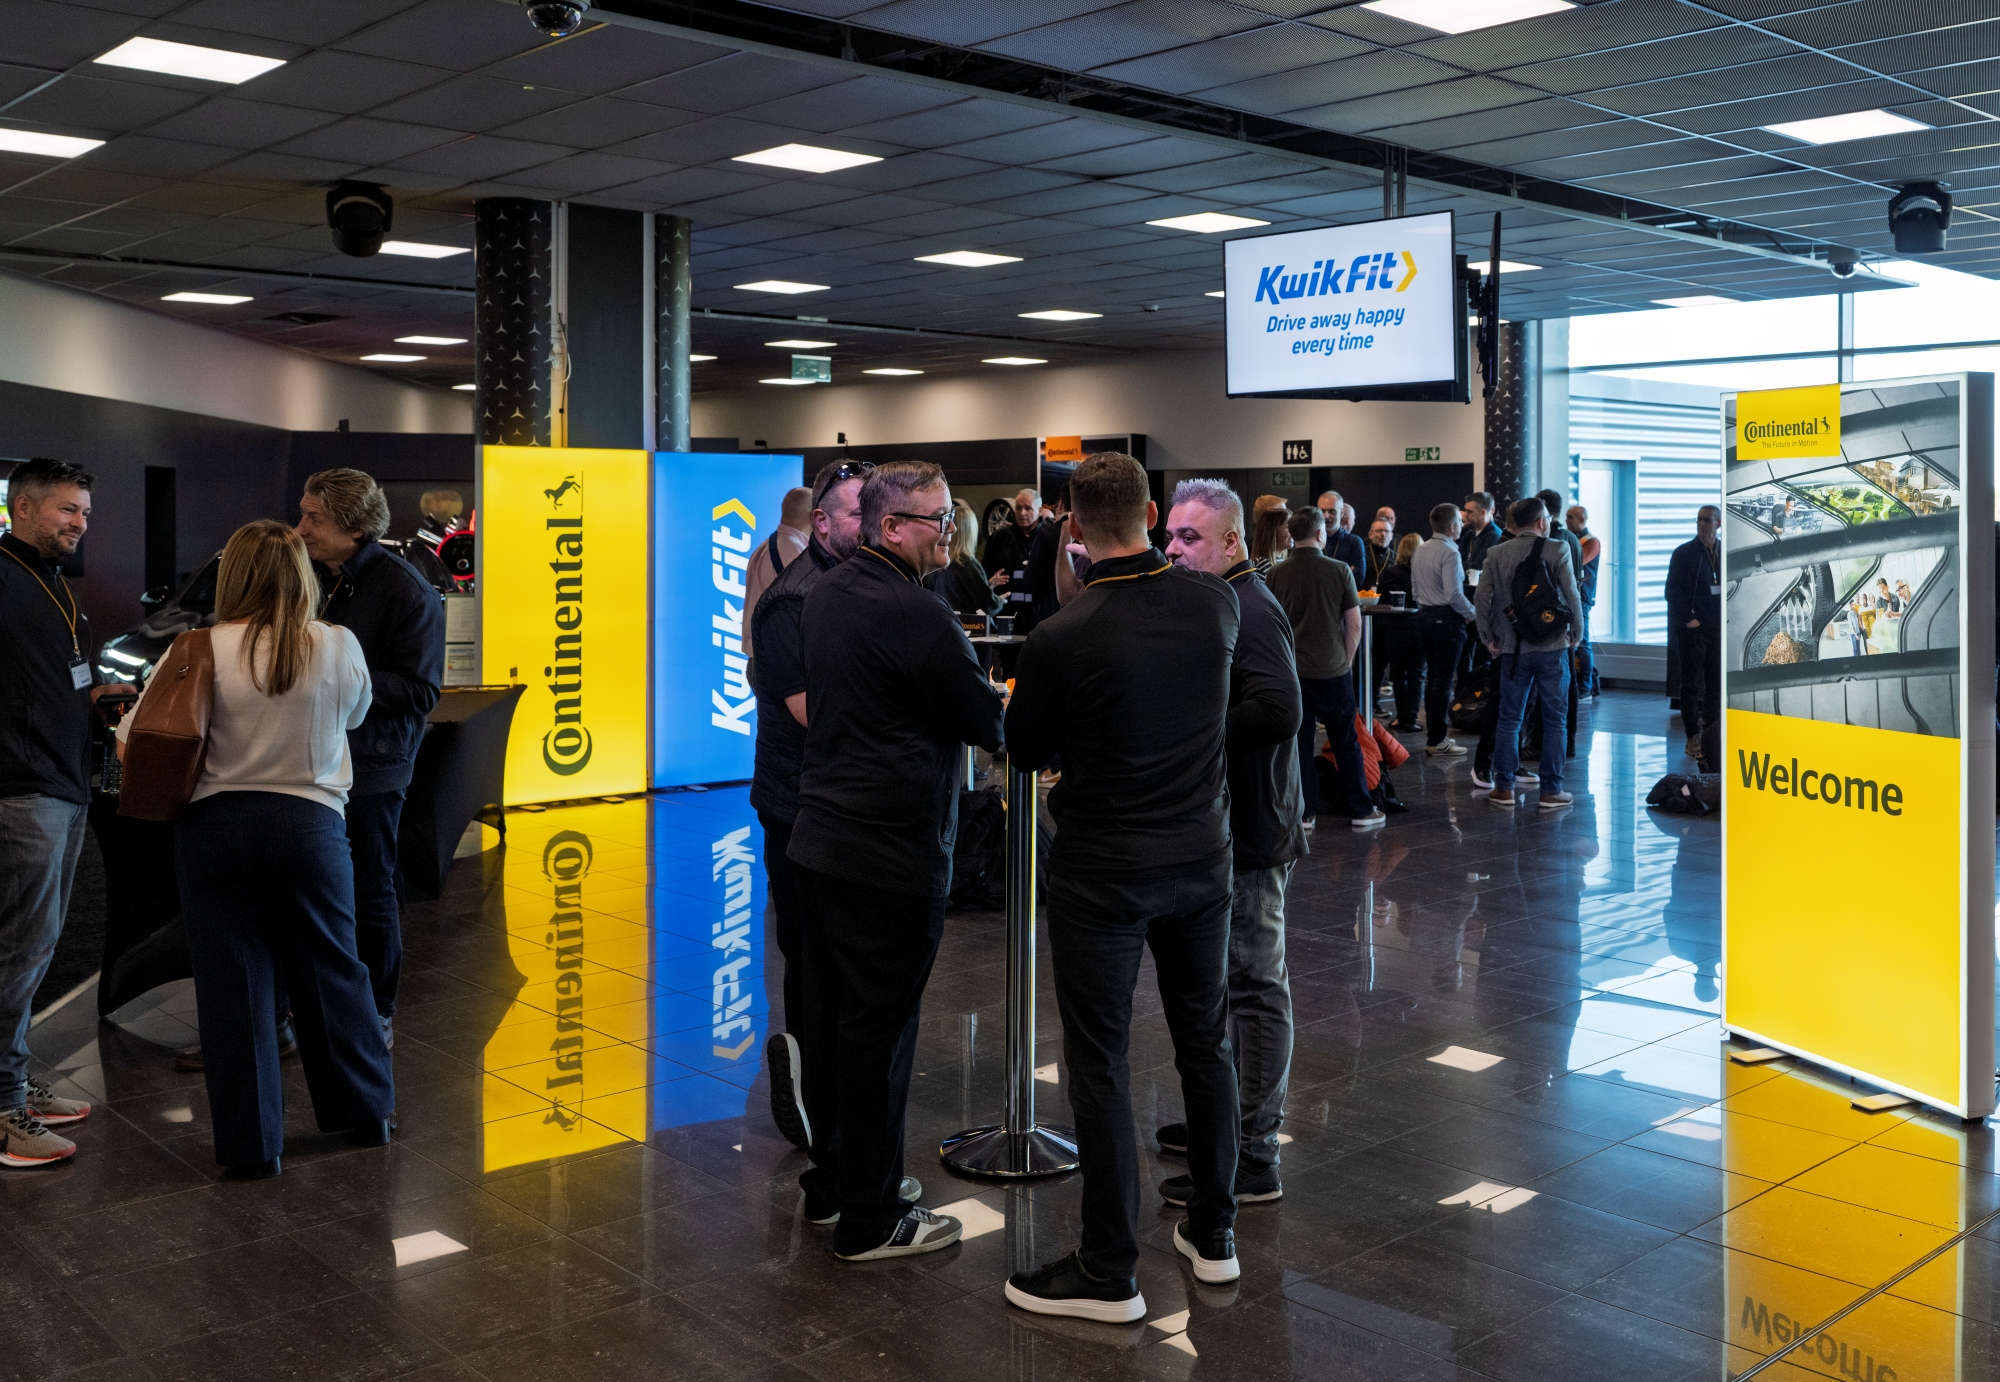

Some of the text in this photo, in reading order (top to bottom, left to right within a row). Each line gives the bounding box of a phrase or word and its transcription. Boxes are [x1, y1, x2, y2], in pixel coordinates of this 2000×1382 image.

[1266, 308, 1405, 332] Drive away happy
[1292, 332, 1374, 356] every time
[1744, 418, 1818, 443] Continental
[1762, 441, 1771, 449] The
[1772, 440, 1791, 448] Future
[1798, 439, 1818, 447] Motion
[543, 515, 592, 776] Continental
[1738, 749, 1903, 816] Welcome
